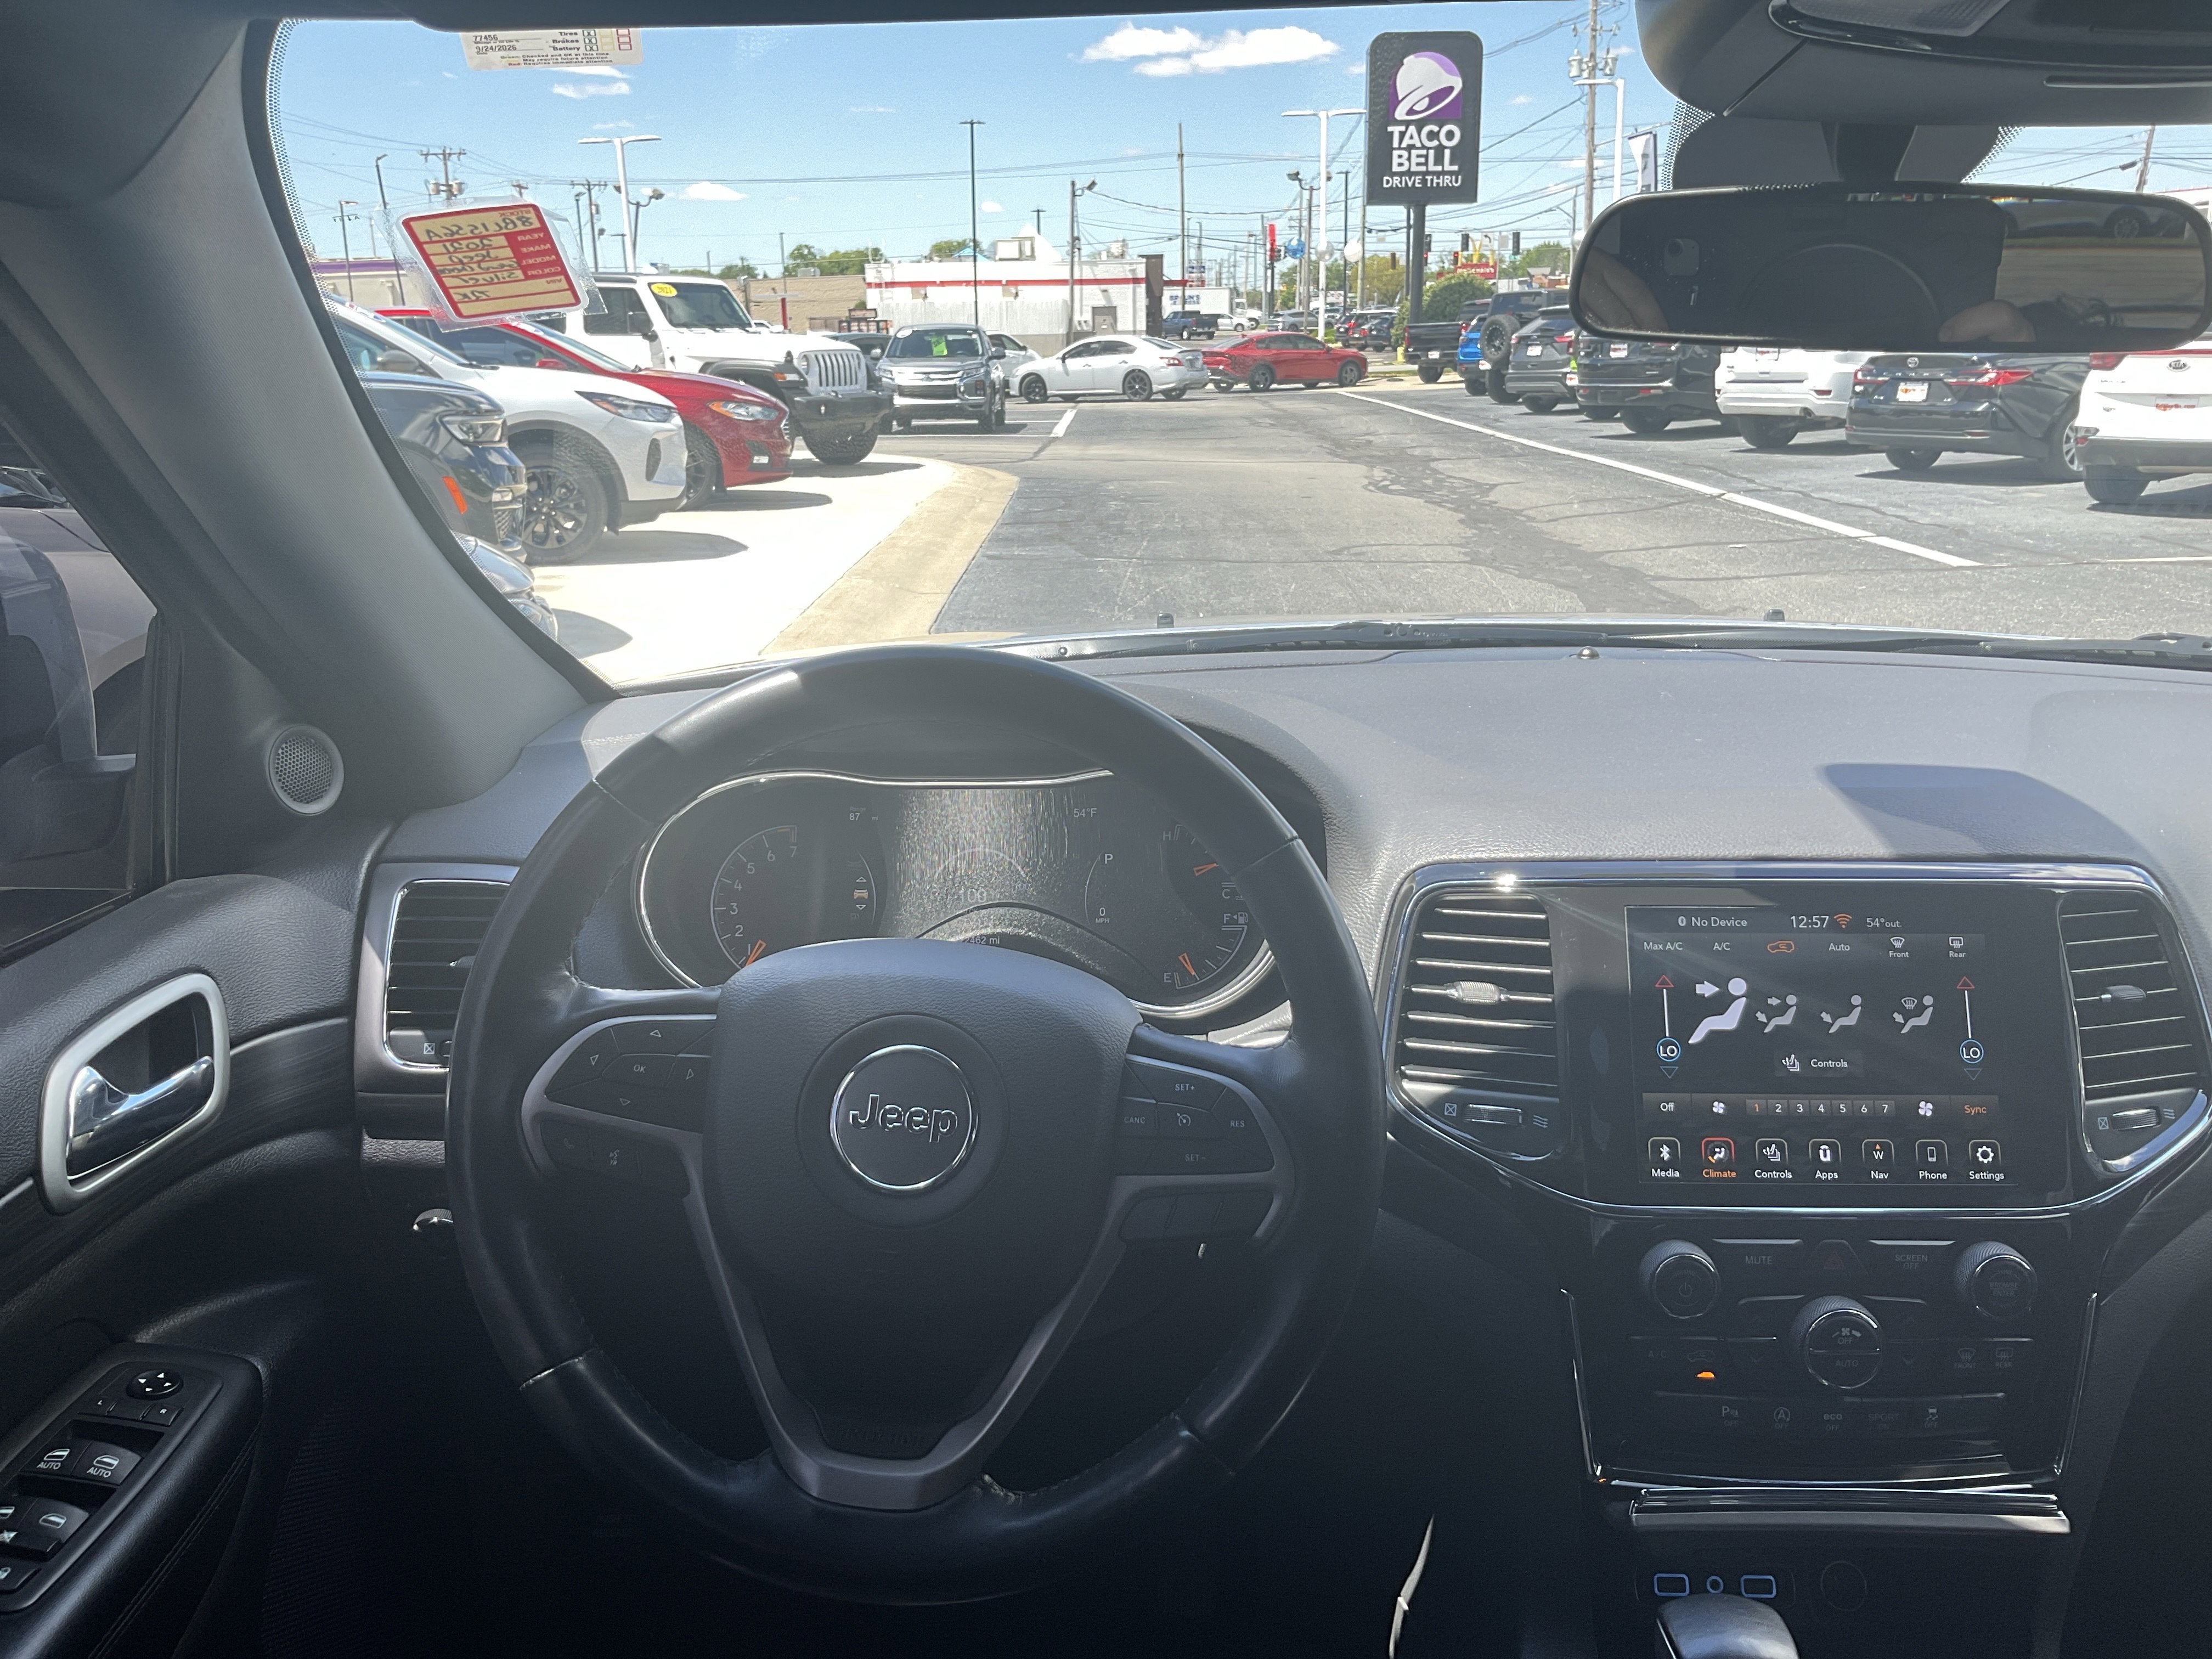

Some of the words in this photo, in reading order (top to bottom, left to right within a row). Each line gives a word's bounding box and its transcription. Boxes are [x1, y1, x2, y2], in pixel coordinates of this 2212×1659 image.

[476, 44, 517, 53] 9/24/2026
[1387, 125, 1461, 148] TACO
[1391, 149, 1459, 172] BELL
[1383, 177, 1423, 188] DRIVE
[1425, 176, 1462, 187] THRU
[849, 812, 861, 821] 87
[1074, 808, 1097, 817] 54°F
[1163, 831, 1171, 840] H
[768, 850, 775, 862] 6
[789, 846, 797, 857] 7
[1104, 854, 1113, 864] P
[747, 862, 755, 874] 5
[734, 879, 742, 891] 4
[1222, 889, 1231, 899] C
[730, 903, 738, 915] 3
[1099, 907, 1105, 916] 0
[1223, 913, 1231, 924] F
[1691, 917, 1708, 928] No
[1712, 917, 1747, 928] Device
[1790, 915, 1830, 929] 12:57
[735, 925, 743, 936] 2
[989, 935, 1000, 944] mi
[1644, 941, 1661, 951] Max
[1663, 941, 1683, 952] A/C
[1713, 941, 1731, 952] A/C
[1829, 942, 1850, 952] Auto
[1889, 950, 1909, 958] Front
[1948, 950, 1966, 959] Rear
[1164, 972, 1171, 983] E
[1659, 1045, 1678, 1058] LO
[1962, 1046, 1980, 1059] LO
[633, 1064, 646, 1073] OK
[1810, 1058, 1848, 1069] Controls
[1660, 1101, 1675, 1113] Off
[1754, 1104, 1759, 1113] 1
[1775, 1104, 1782, 1113] 2
[1796, 1104, 1803, 1114] 3
[1817, 1104, 1825, 1114] 4
[1839, 1104, 1846, 1114] 5
[1860, 1104, 1867, 1114] 6
[1882, 1104, 1888, 1114] 7
[1964, 1104, 1987, 1116] Sync
[849, 1094, 958, 1143] Jeep
[1124, 1116, 1146, 1125] CANC
[1229, 1119, 1245, 1128] RES
[1872, 1149, 1884, 1160] W
[1651, 1169, 1680, 1178] Media
[1702, 1169, 1736, 1178] Climate
[1754, 1169, 1792, 1180] Controls
[1815, 1170, 1838, 1181] Apps
[1871, 1171, 1889, 1180] Nav
[1918, 1170, 1948, 1180] Phone
[1968, 1170, 2005, 1182] Settings
[1745, 1256, 1773, 1265] MUTE
[1895, 1254, 1928, 1262] SCREEN
[1648, 1350, 1667, 1358] A/C
[1722, 1406, 1730, 1417] P
[1777, 1410, 1786, 1419] A
[1823, 1413, 1842, 1421] eco
[1867, 1413, 1899, 1421] SPORT
[37, 1461, 61, 1470] AUTO
[87, 1466, 111, 1478] AUTO
